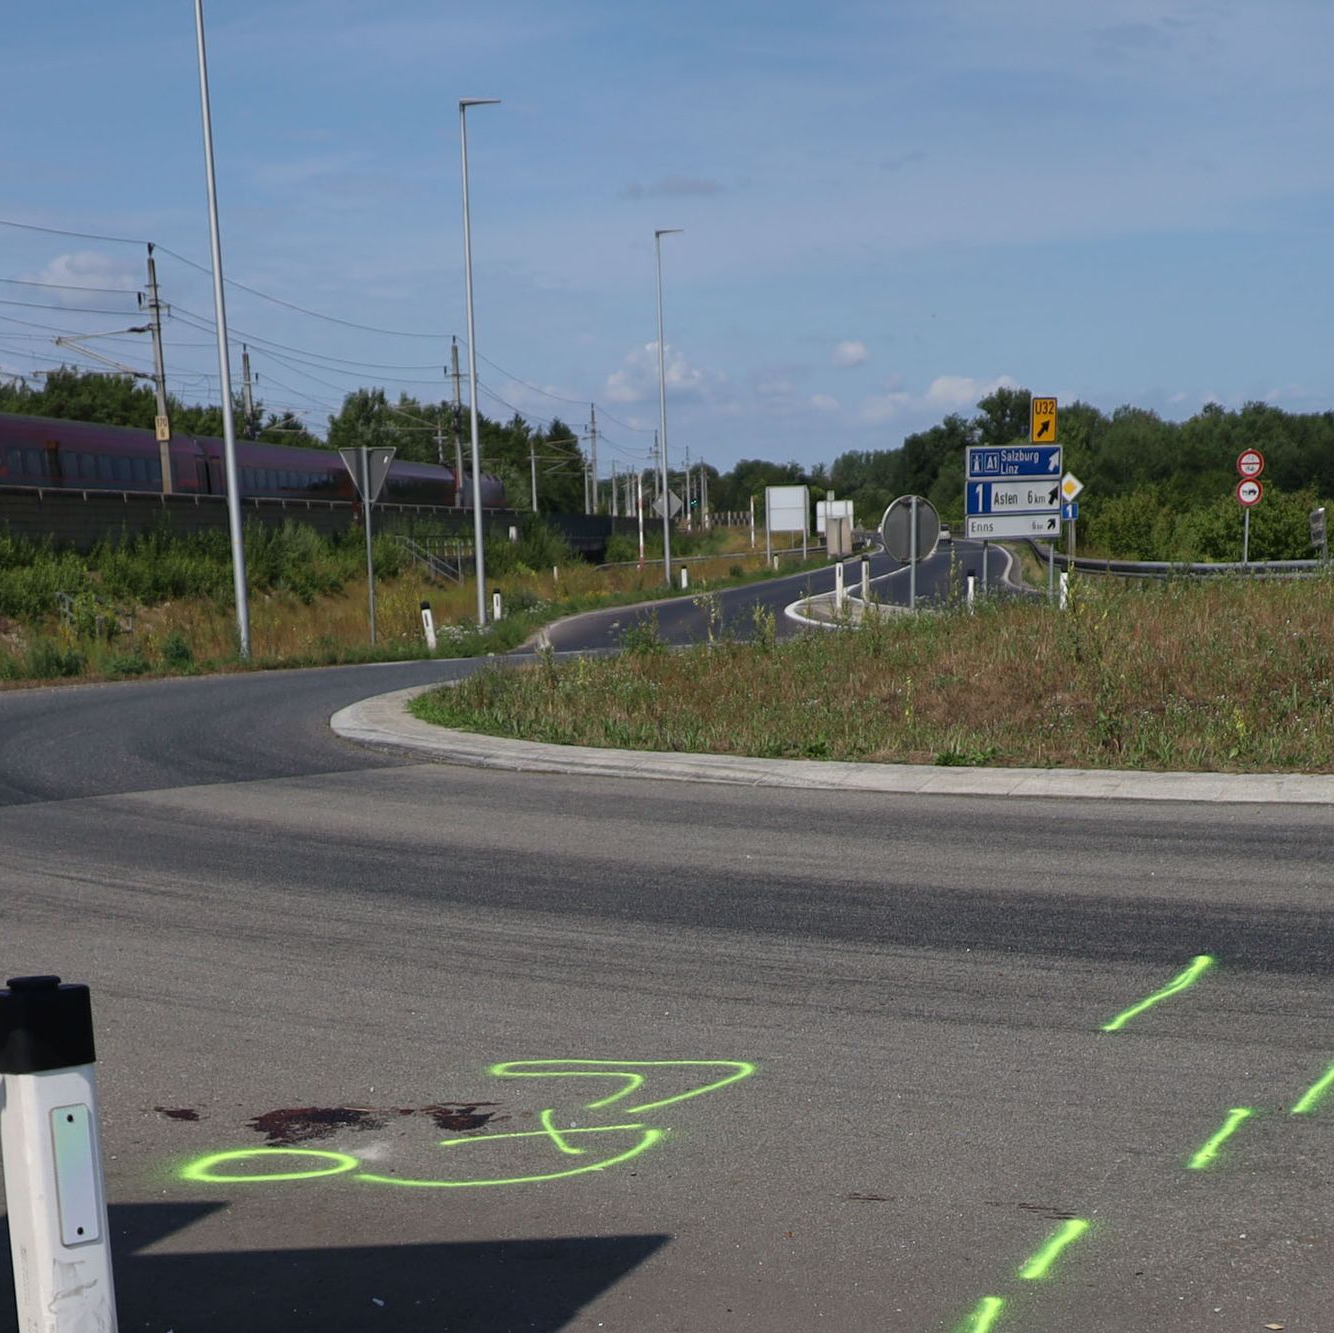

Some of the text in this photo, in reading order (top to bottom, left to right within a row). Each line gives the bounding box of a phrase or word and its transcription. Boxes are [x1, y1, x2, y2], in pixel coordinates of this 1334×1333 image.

[1034, 401, 1055, 415] U32
[987, 455, 998, 470] A1
[1000, 450, 1040, 464] Salzburg
[1000, 463, 1019, 475] Linz
[975, 483, 984, 513] 1
[994, 490, 1046, 505] Asten 6 km
[1066, 504, 1073, 518] 1
[971, 522, 994, 532] Enns
